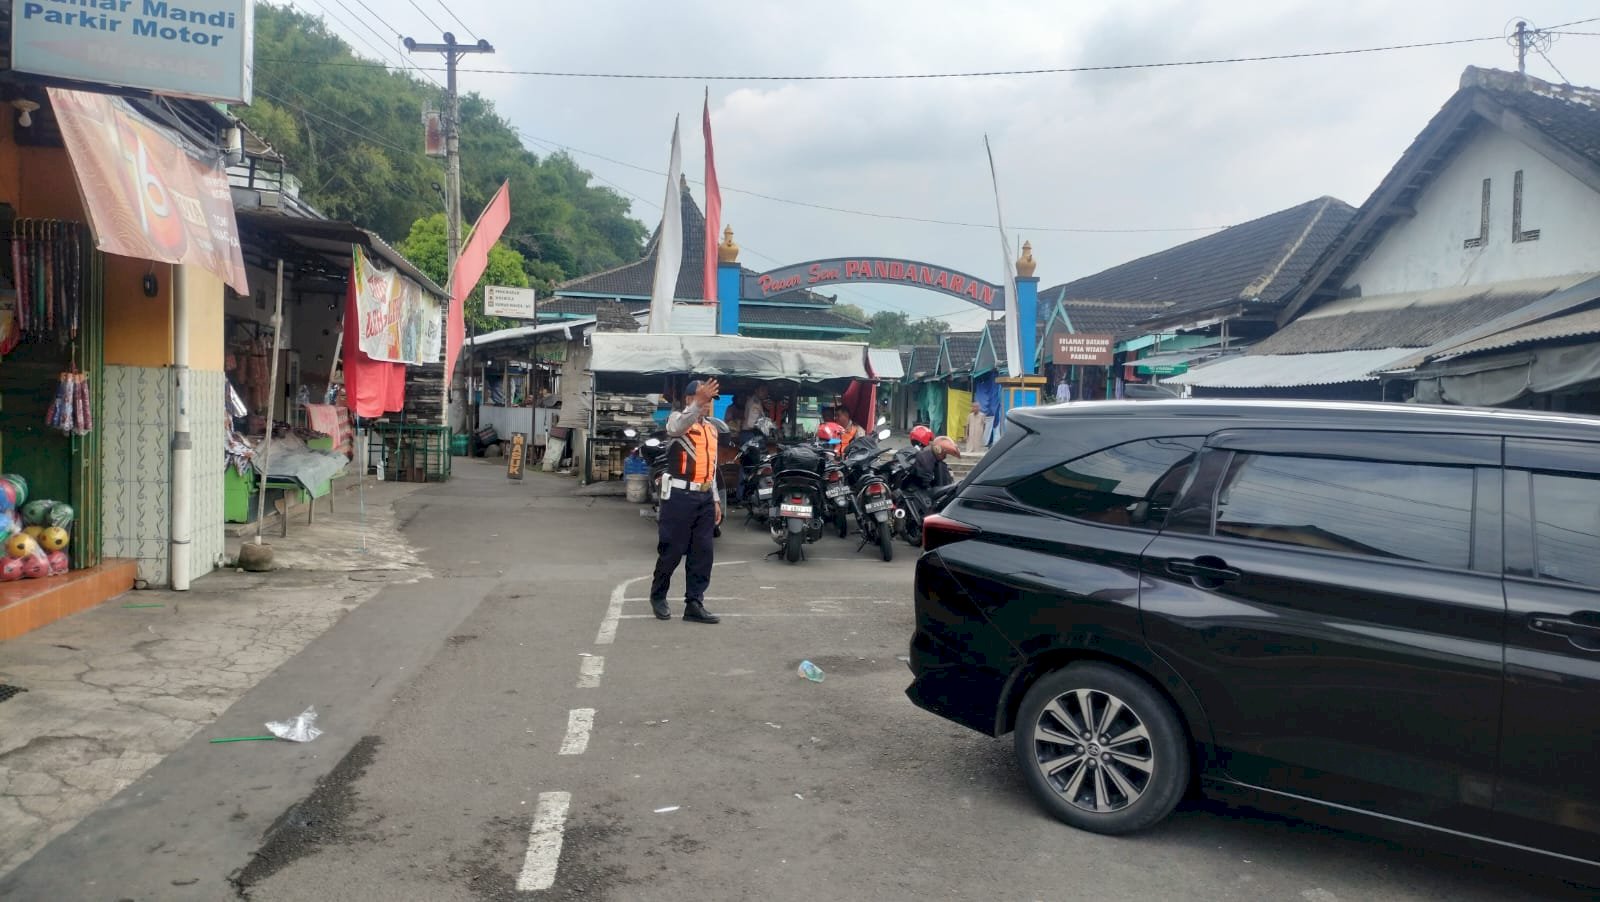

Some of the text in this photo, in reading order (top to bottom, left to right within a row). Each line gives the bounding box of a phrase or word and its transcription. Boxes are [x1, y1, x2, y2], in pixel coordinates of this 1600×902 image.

[23, 2, 224, 47] Parkir Motor
[143, 0, 236, 29] Mandi
[757, 273, 802, 297] Pasar
[845, 260, 997, 305] PANDANARAN
[1061, 345, 1068, 353] DI
